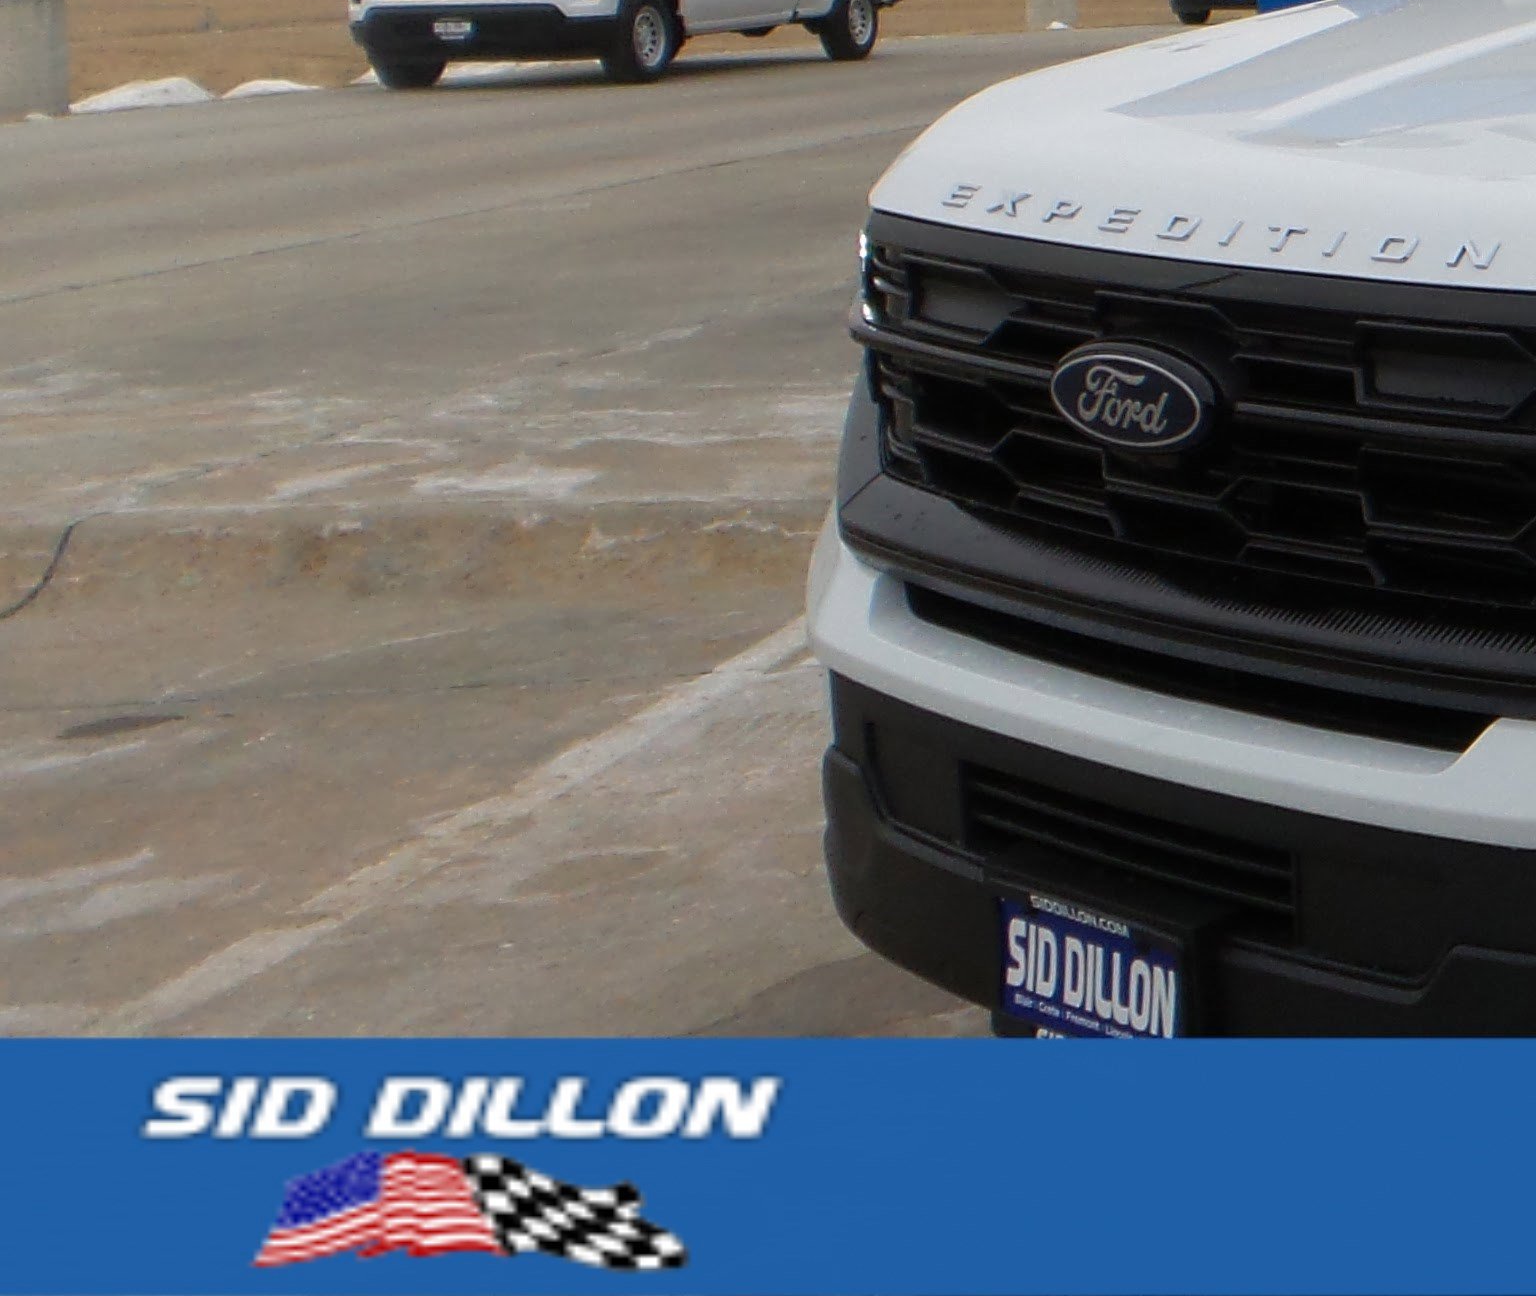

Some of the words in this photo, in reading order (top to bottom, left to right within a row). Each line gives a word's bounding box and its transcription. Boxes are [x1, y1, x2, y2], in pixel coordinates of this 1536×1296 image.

[940, 184, 1502, 270] EXPEDITION
[1075, 363, 1169, 437] Ford
[1005, 917, 1057, 999] SID
[1062, 935, 1177, 1039] DILLON
